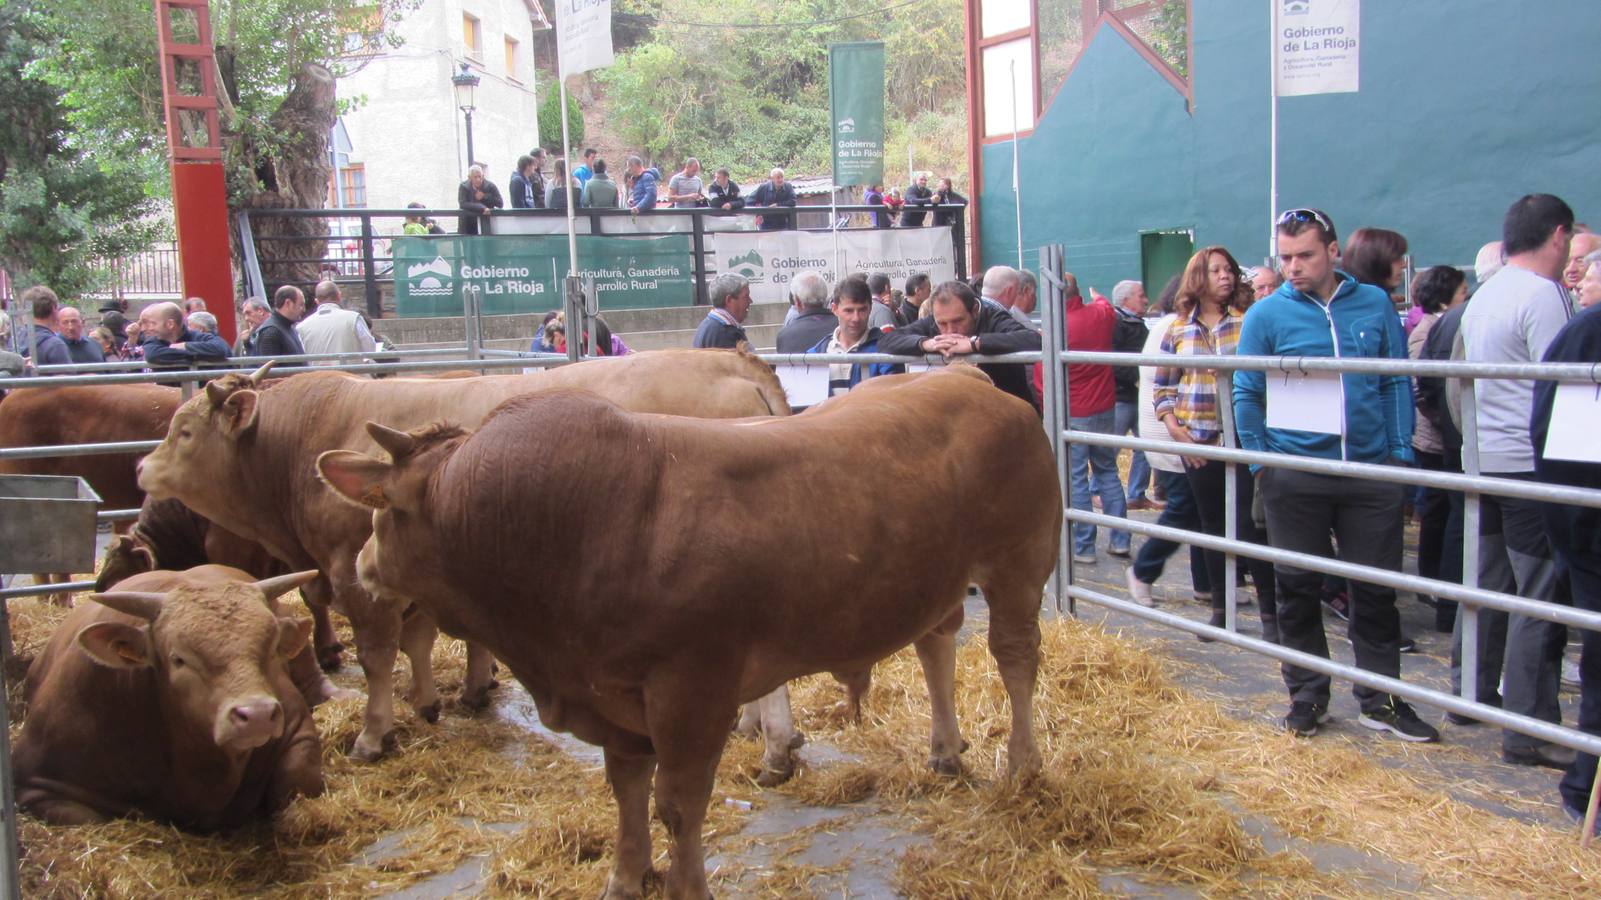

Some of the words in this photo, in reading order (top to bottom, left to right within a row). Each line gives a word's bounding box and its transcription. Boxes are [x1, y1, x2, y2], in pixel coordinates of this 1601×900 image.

[1283, 25, 1344, 39] Gobierno
[1283, 41, 1300, 52] de
[1303, 39, 1319, 51] La
[1323, 37, 1356, 50] Rioja
[838, 139, 876, 148] Gobierno
[838, 149, 849, 157] de
[851, 149, 862, 157] La
[771, 256, 827, 269] Gobierno
[855, 259, 904, 271] Agricultura,
[460, 265, 529, 279] Gobierno
[772, 271, 788, 283] de
[462, 282, 481, 293] de
[485, 281, 503, 294] La
[507, 281, 544, 295] Rioja
[631, 279, 658, 290] Rural
